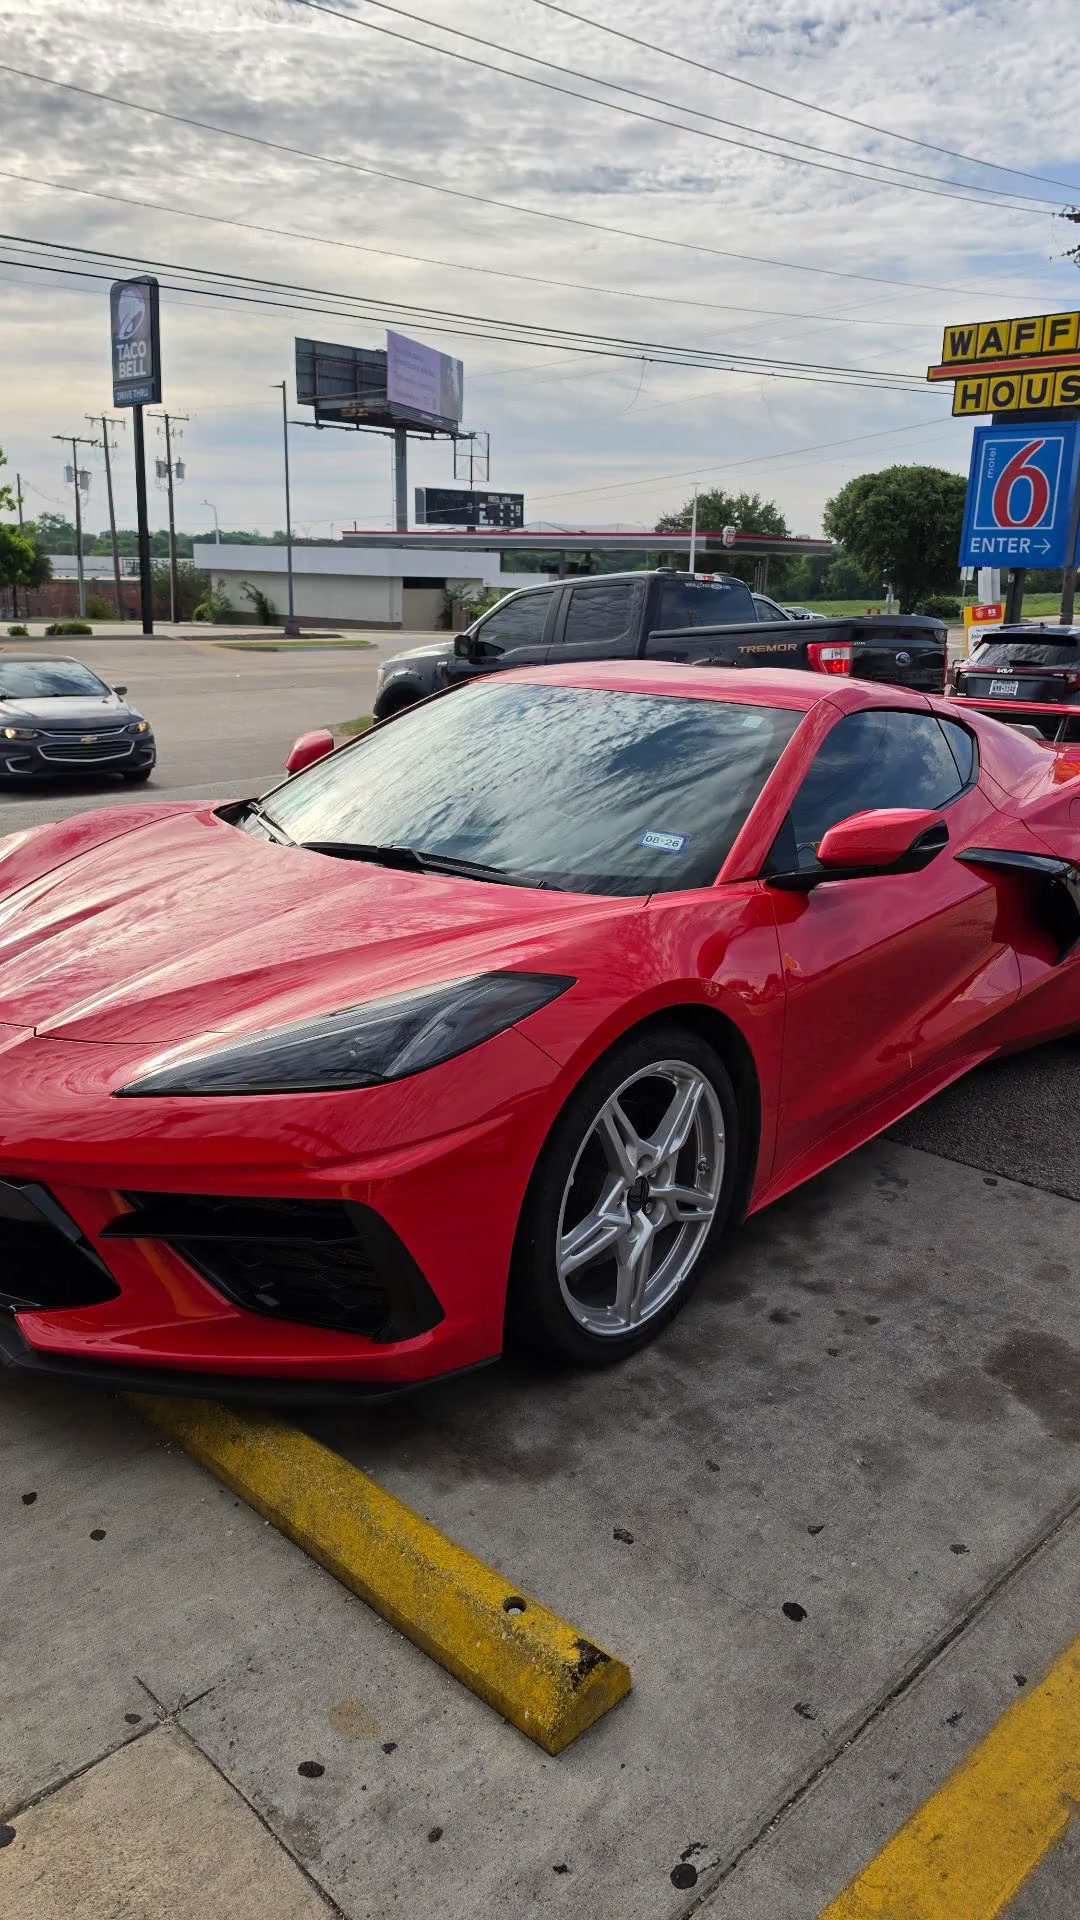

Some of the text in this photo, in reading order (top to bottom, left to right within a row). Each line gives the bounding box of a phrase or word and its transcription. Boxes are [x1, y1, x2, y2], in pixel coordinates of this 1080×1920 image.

[116, 341, 147, 361] TACO
[119, 359, 147, 379] BELL
[987, 447, 997, 479] motel
[991, 438, 1050, 529] 6
[970, 537, 1031, 554] ENTER
[738, 643, 799, 654] TREMOR
